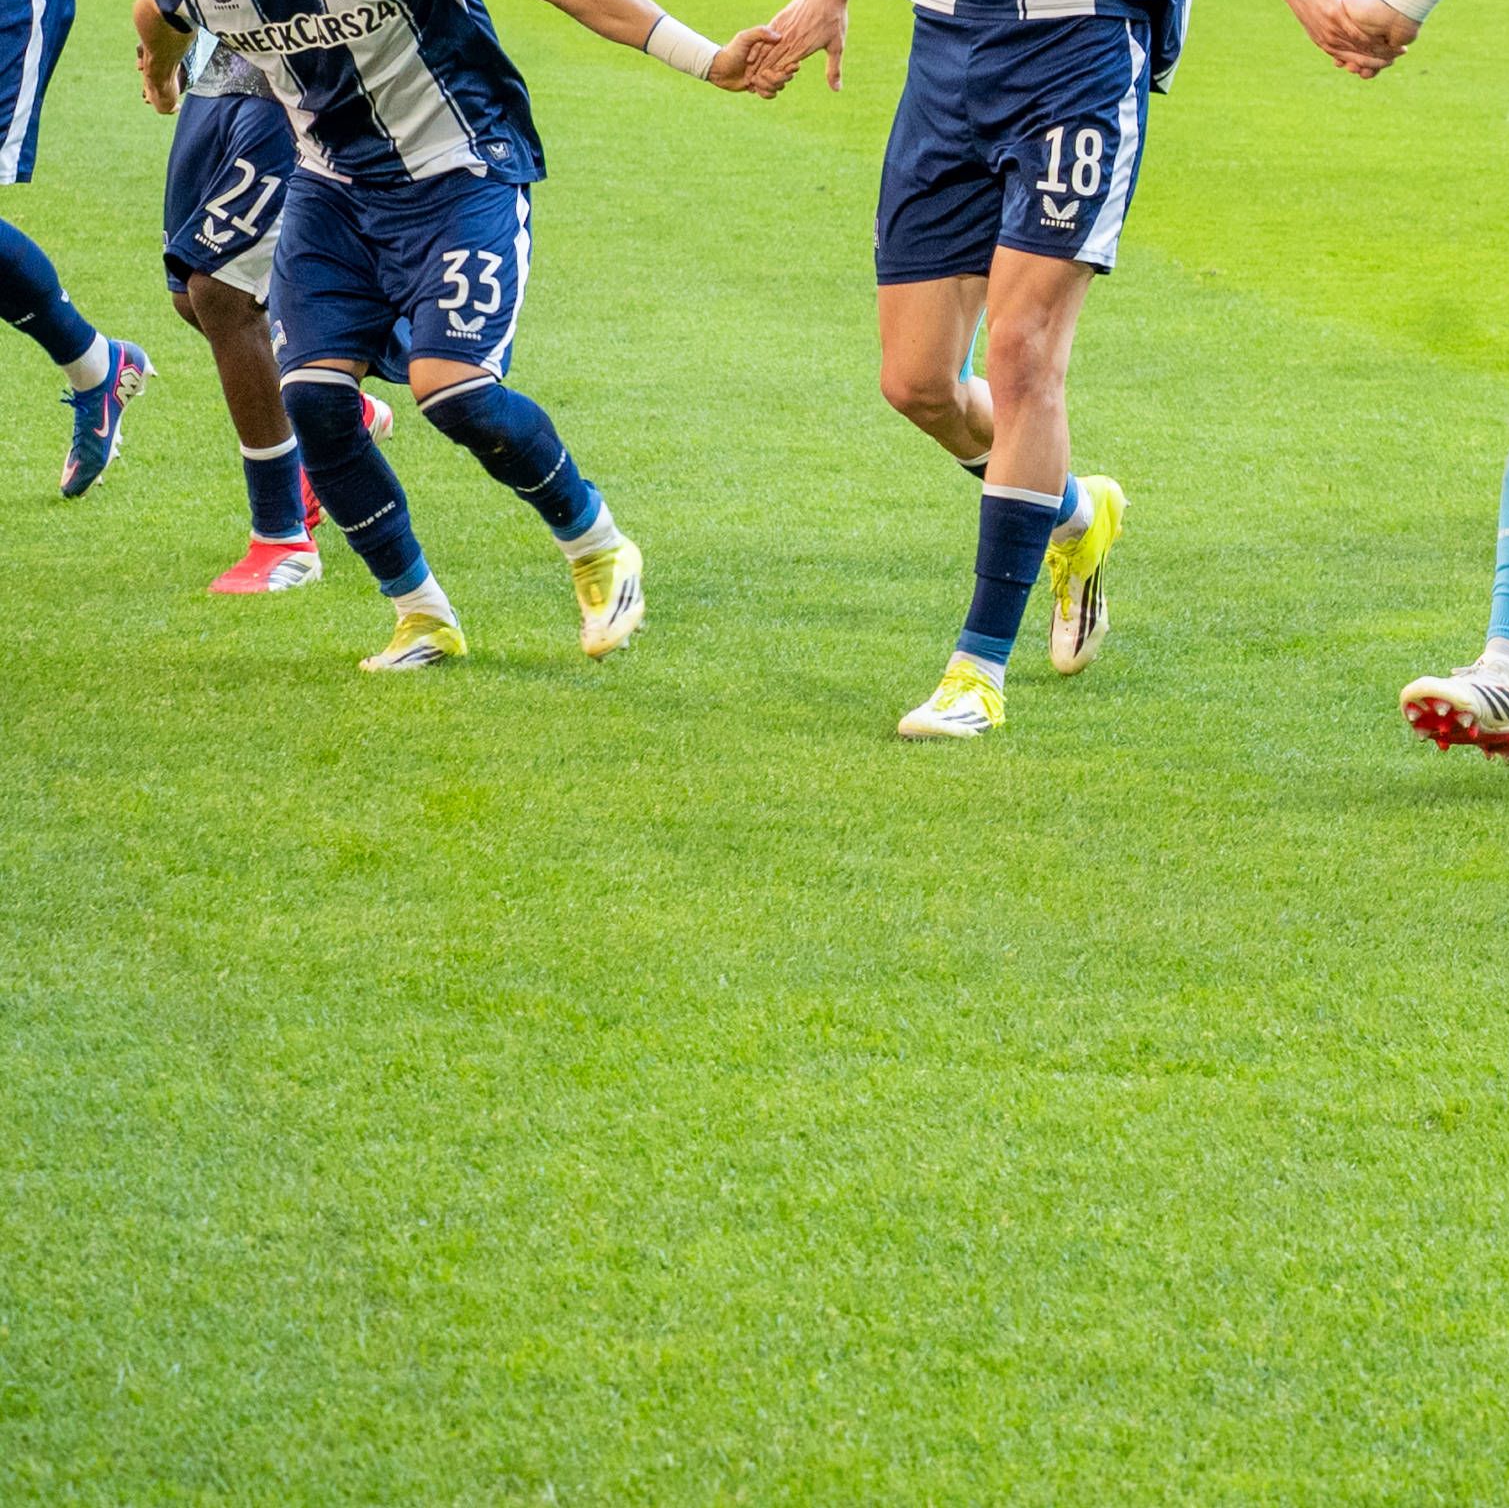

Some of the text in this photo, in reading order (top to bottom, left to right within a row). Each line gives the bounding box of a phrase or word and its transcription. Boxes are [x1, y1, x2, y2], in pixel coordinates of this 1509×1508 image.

[1035, 126, 1103, 197] 18
[206, 158, 283, 237] 21
[437, 249, 503, 314] 33
